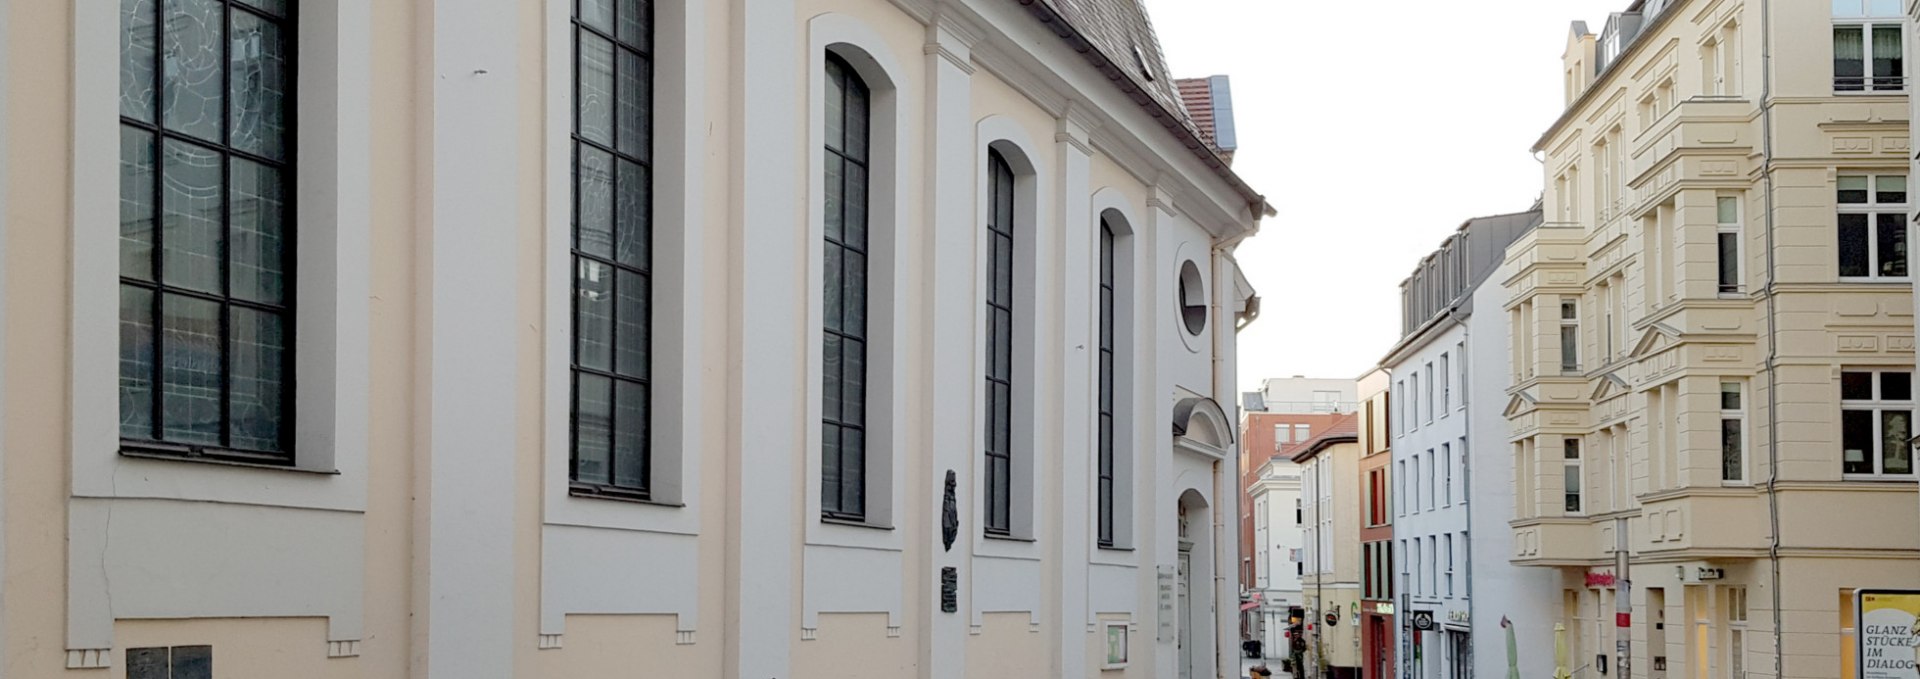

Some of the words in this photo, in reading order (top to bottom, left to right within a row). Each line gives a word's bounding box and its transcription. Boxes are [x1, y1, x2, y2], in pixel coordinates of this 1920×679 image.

[1866, 625, 1907, 635] GLANZ
[1866, 635, 1912, 647] STÜCKE
[1867, 648, 1883, 658] IM
[1867, 659, 1914, 669] DIALOG
